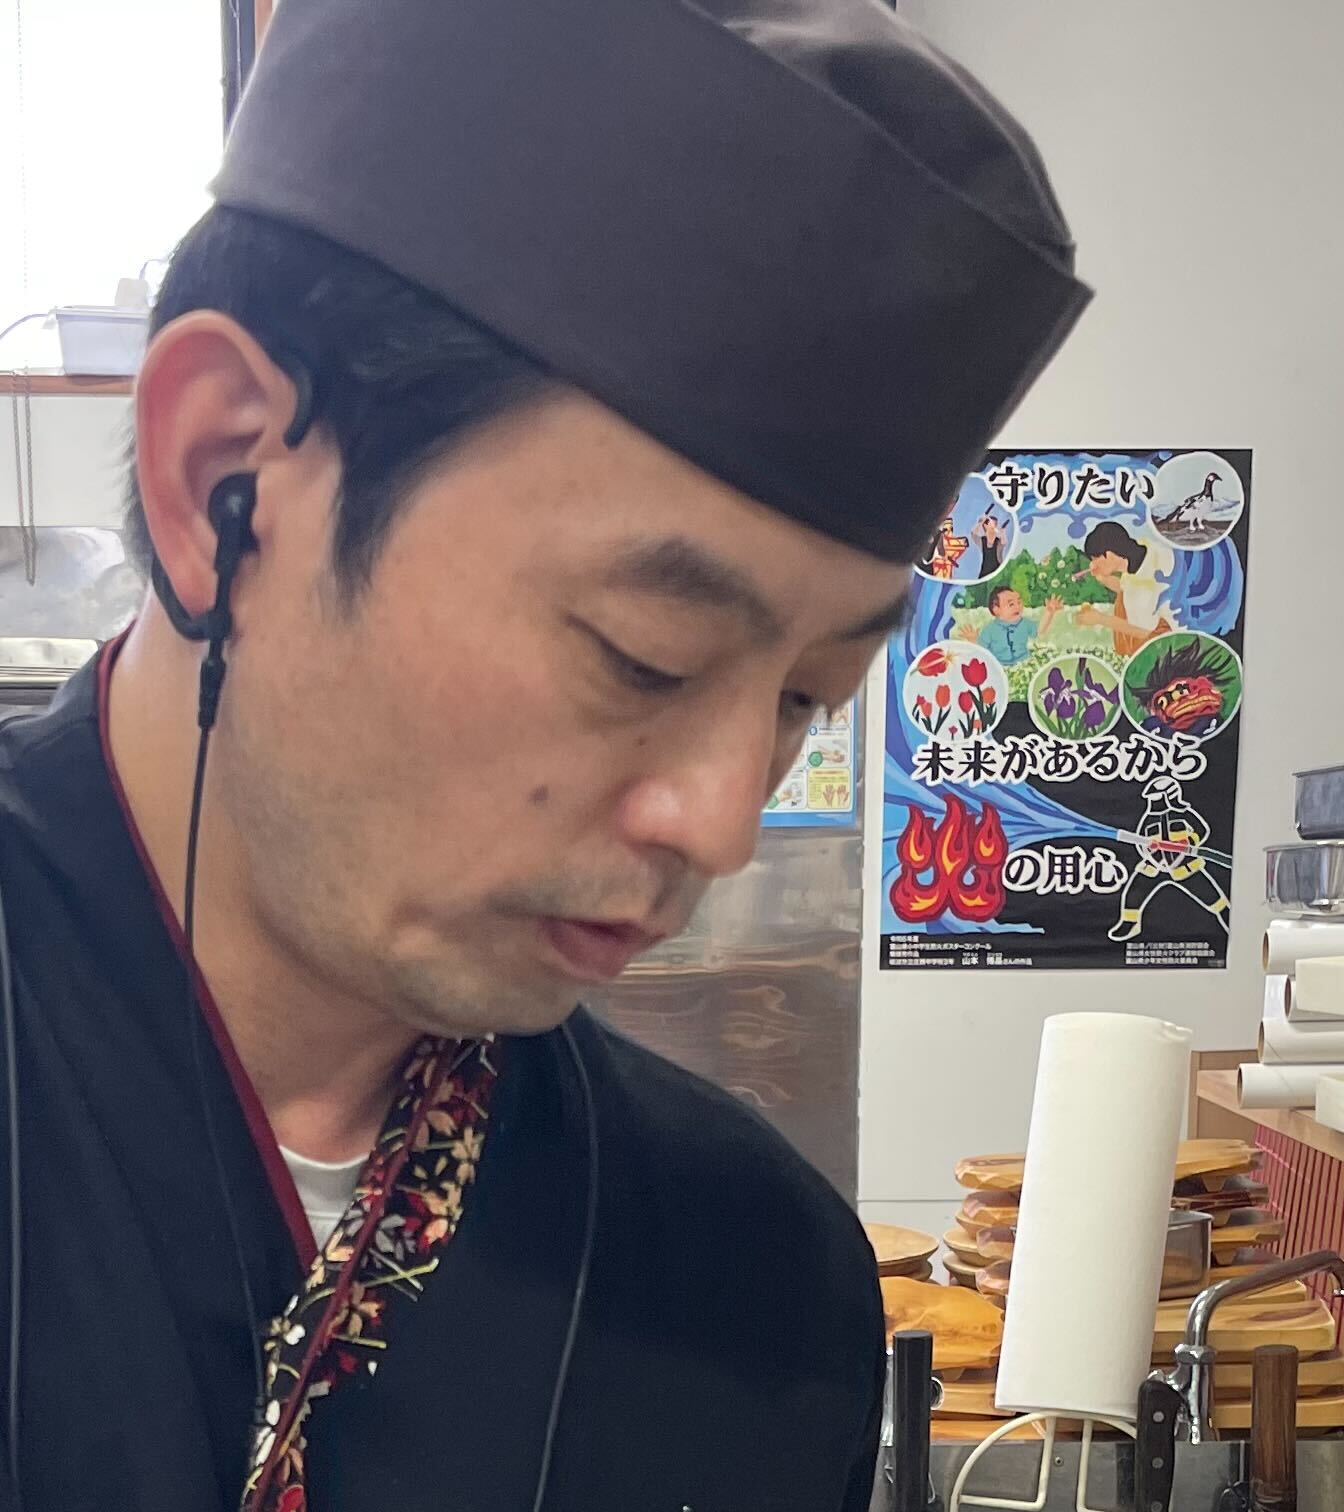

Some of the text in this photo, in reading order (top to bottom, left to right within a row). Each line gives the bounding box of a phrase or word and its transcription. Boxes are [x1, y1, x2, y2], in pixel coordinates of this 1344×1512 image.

[987, 463, 1157, 508] 守りたい
[913, 736, 1206, 782] 未来があるから
[890, 793, 1127, 923] 火の用心
